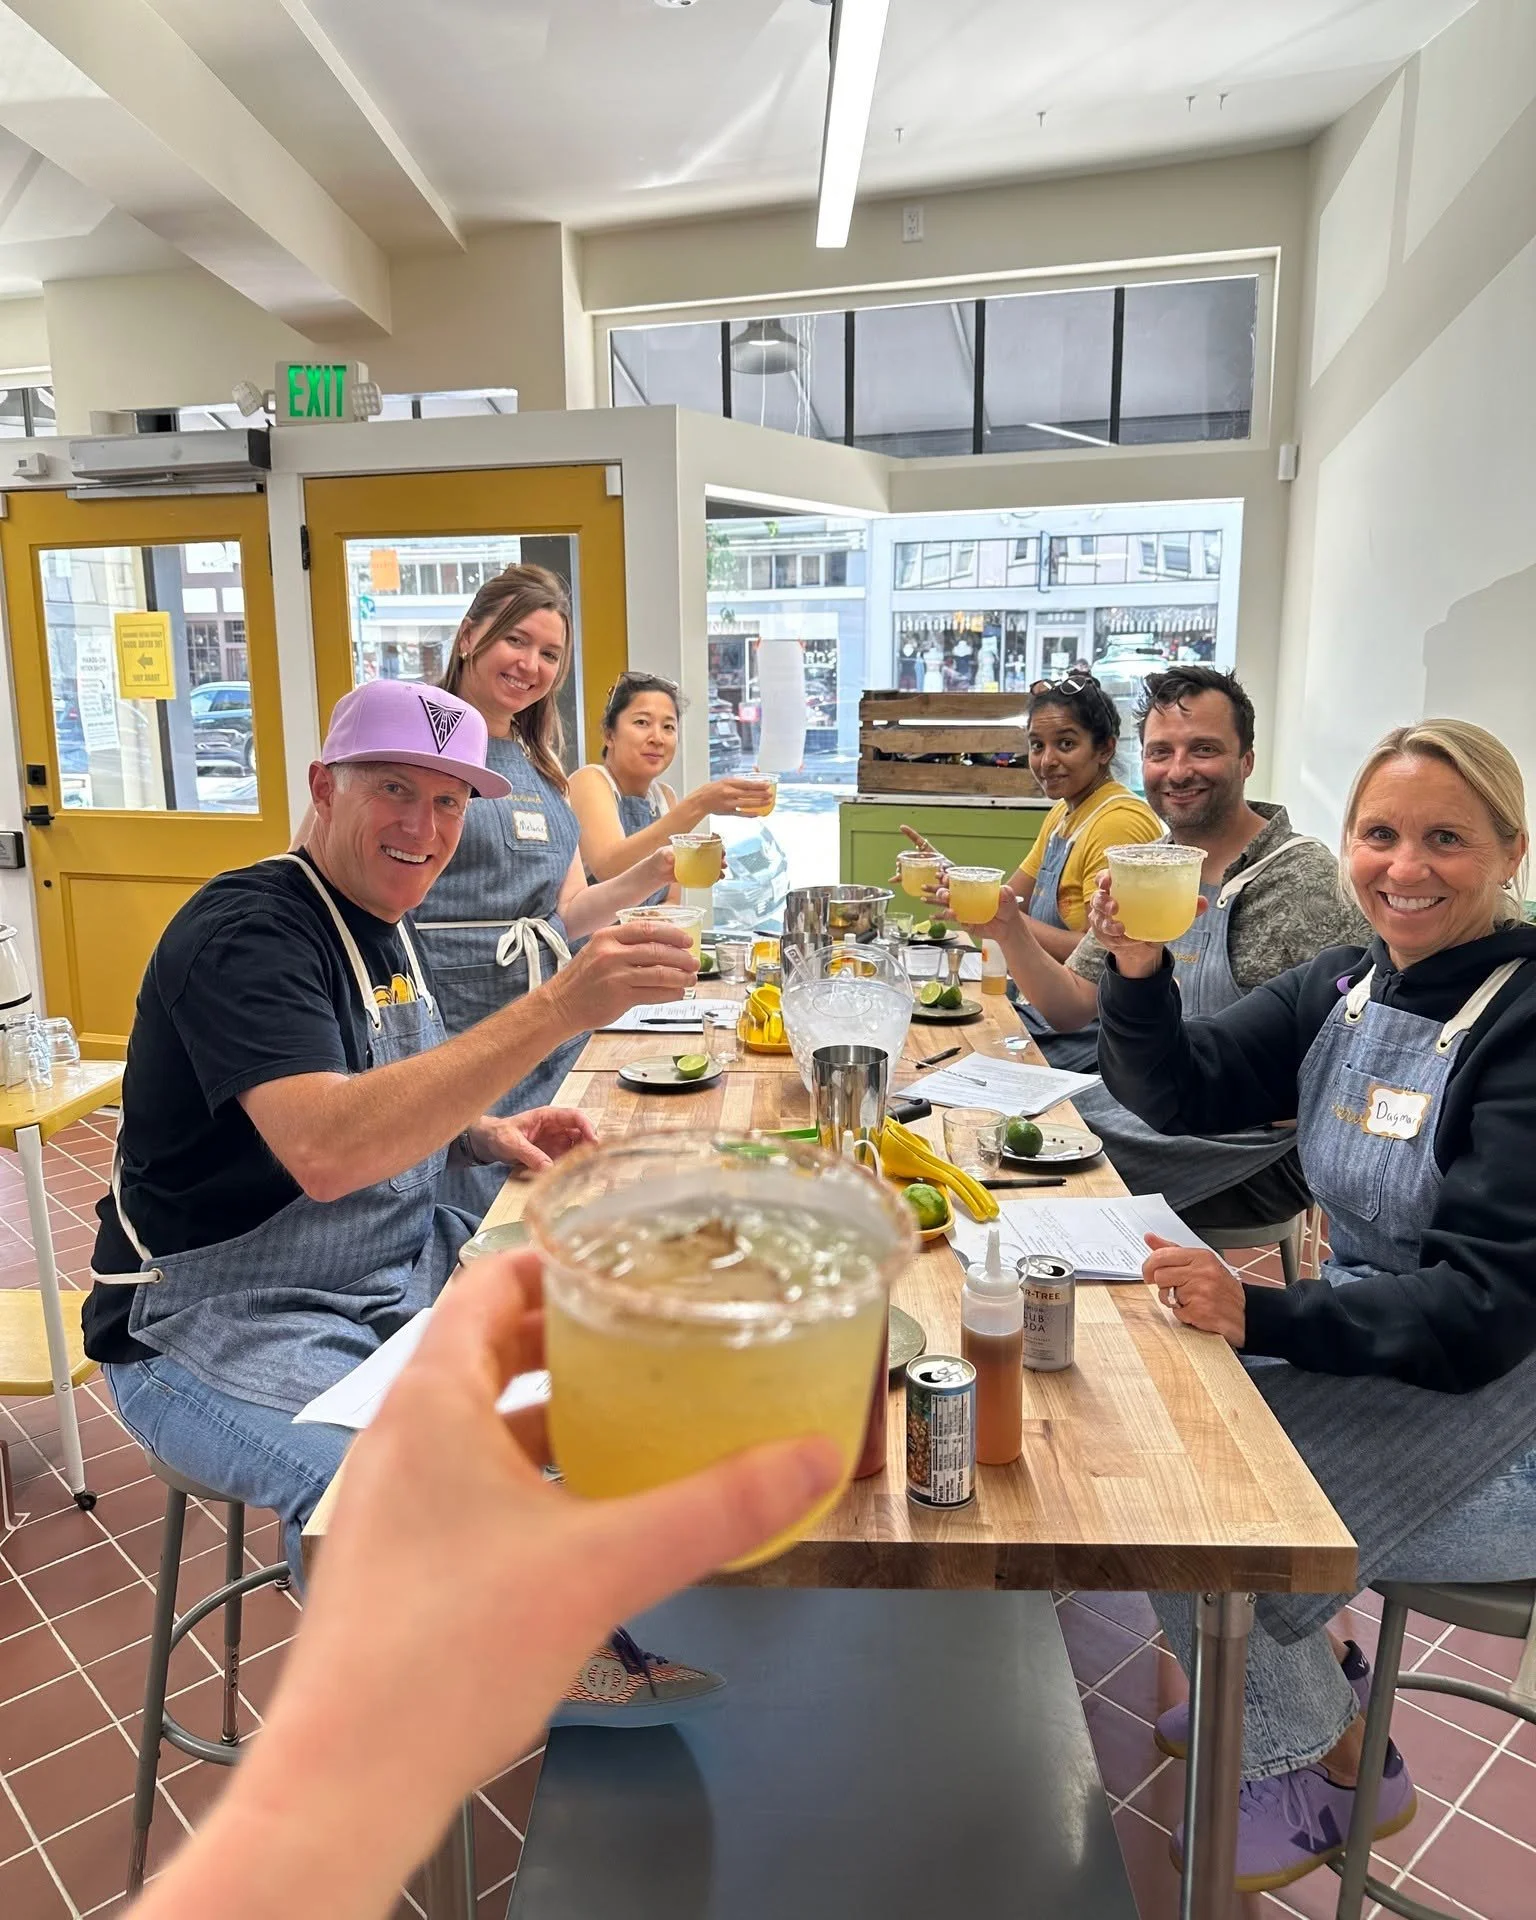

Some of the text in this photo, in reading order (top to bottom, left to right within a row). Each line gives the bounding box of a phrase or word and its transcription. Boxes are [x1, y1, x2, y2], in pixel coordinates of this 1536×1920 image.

[287, 364, 347, 417] EXIT
[1376, 1100, 1418, 1127] Dagmar
[1023, 1311, 1045, 1324] LUB
[1023, 1321, 1046, 1334] ODA
